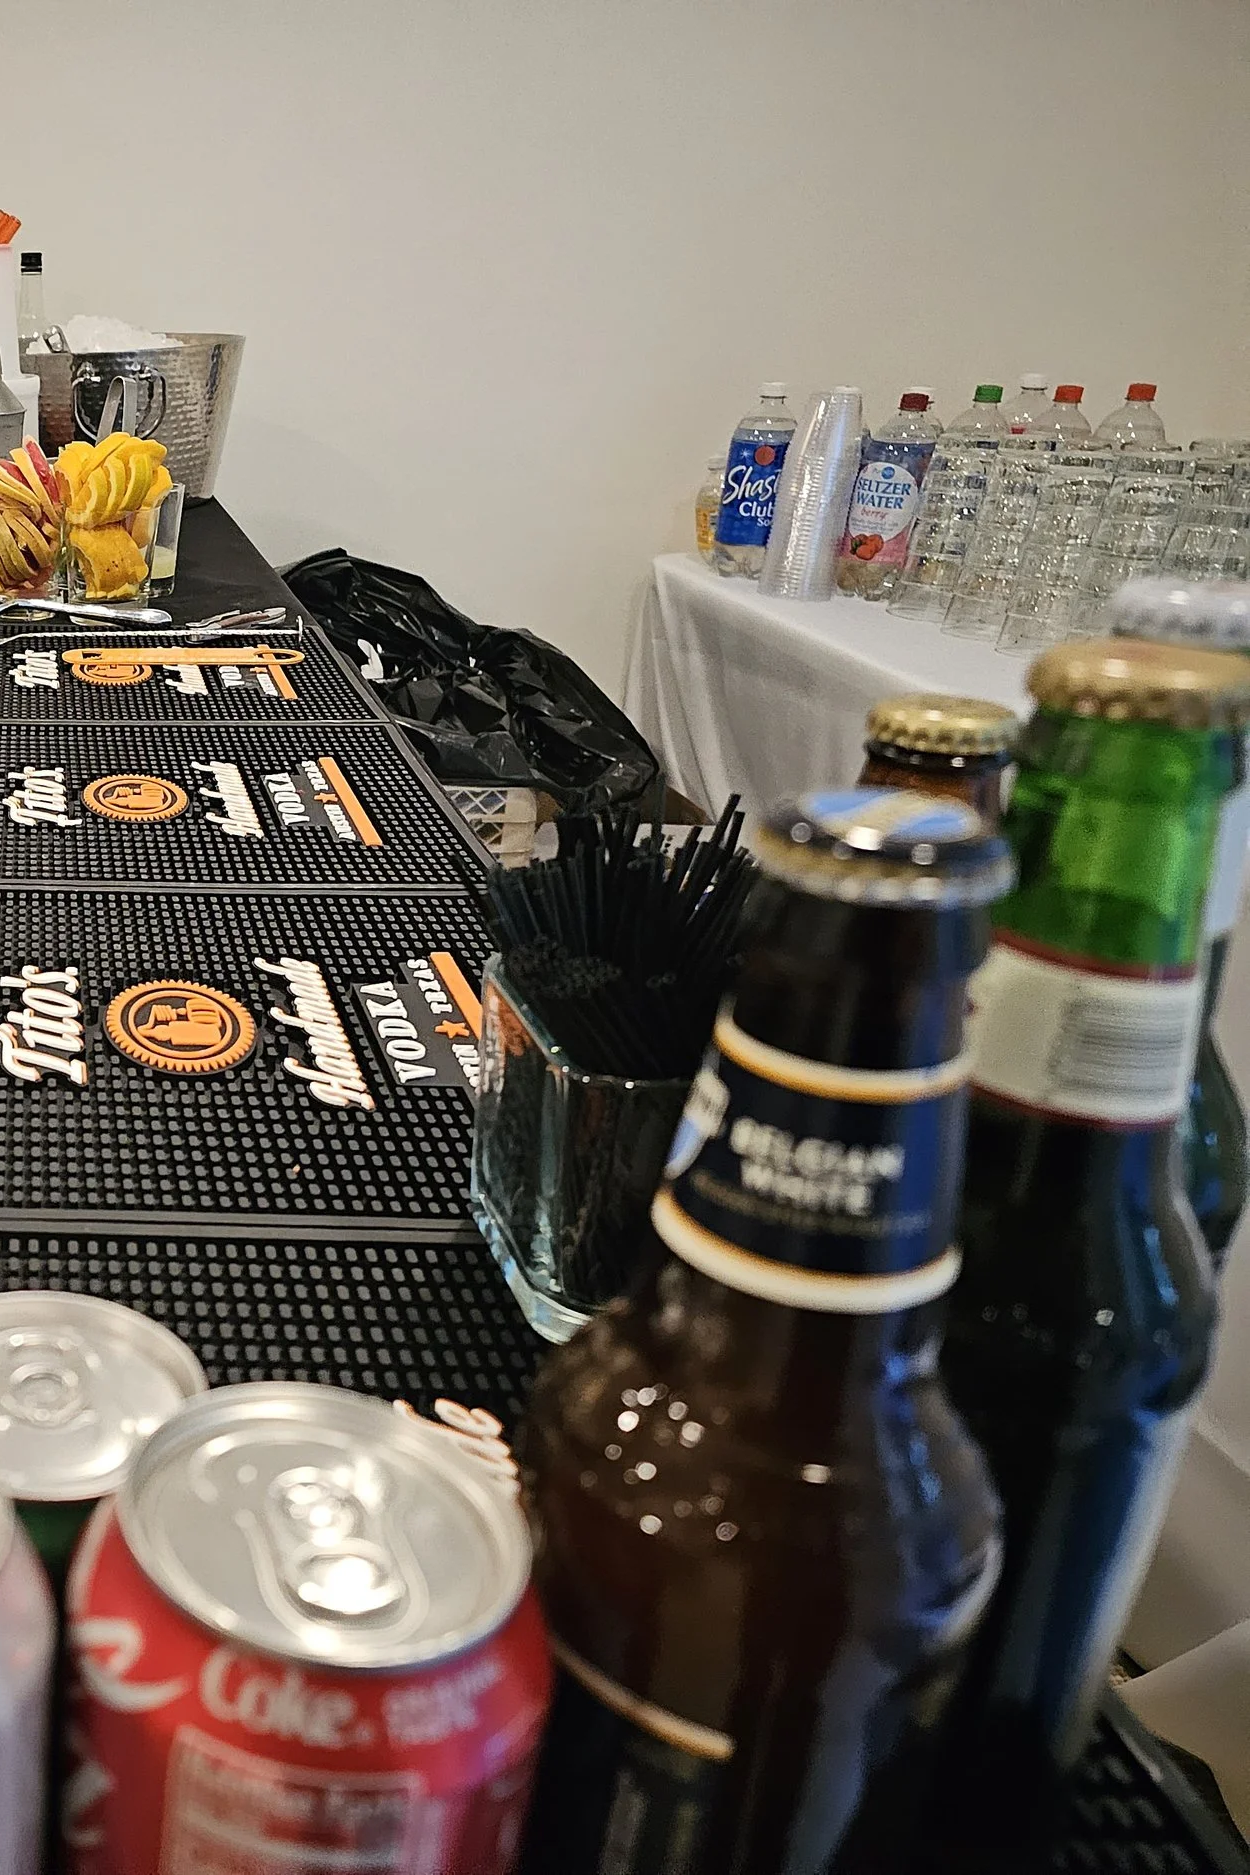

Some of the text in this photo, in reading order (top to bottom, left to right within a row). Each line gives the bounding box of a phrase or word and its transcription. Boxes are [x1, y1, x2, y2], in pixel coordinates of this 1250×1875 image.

[723, 465, 781, 504] Shast
[857, 476, 911, 496] SELTZER
[857, 491, 904, 509] WATER
[218, 665, 246, 688] VOD
[4, 766, 82, 827] Tito's
[190, 761, 265, 839] Handmade
[264, 772, 311, 826] VODKA
[301, 760, 330, 791] TEXAS
[406, 958, 453, 1015] TEXAS
[253, 955, 376, 1112] Handmade
[359, 980, 437, 1084] VODKA
[729, 1116, 905, 1184] BELGIAN
[740, 1157, 872, 1217] WHITE
[200, 1640, 357, 1750] Coke
